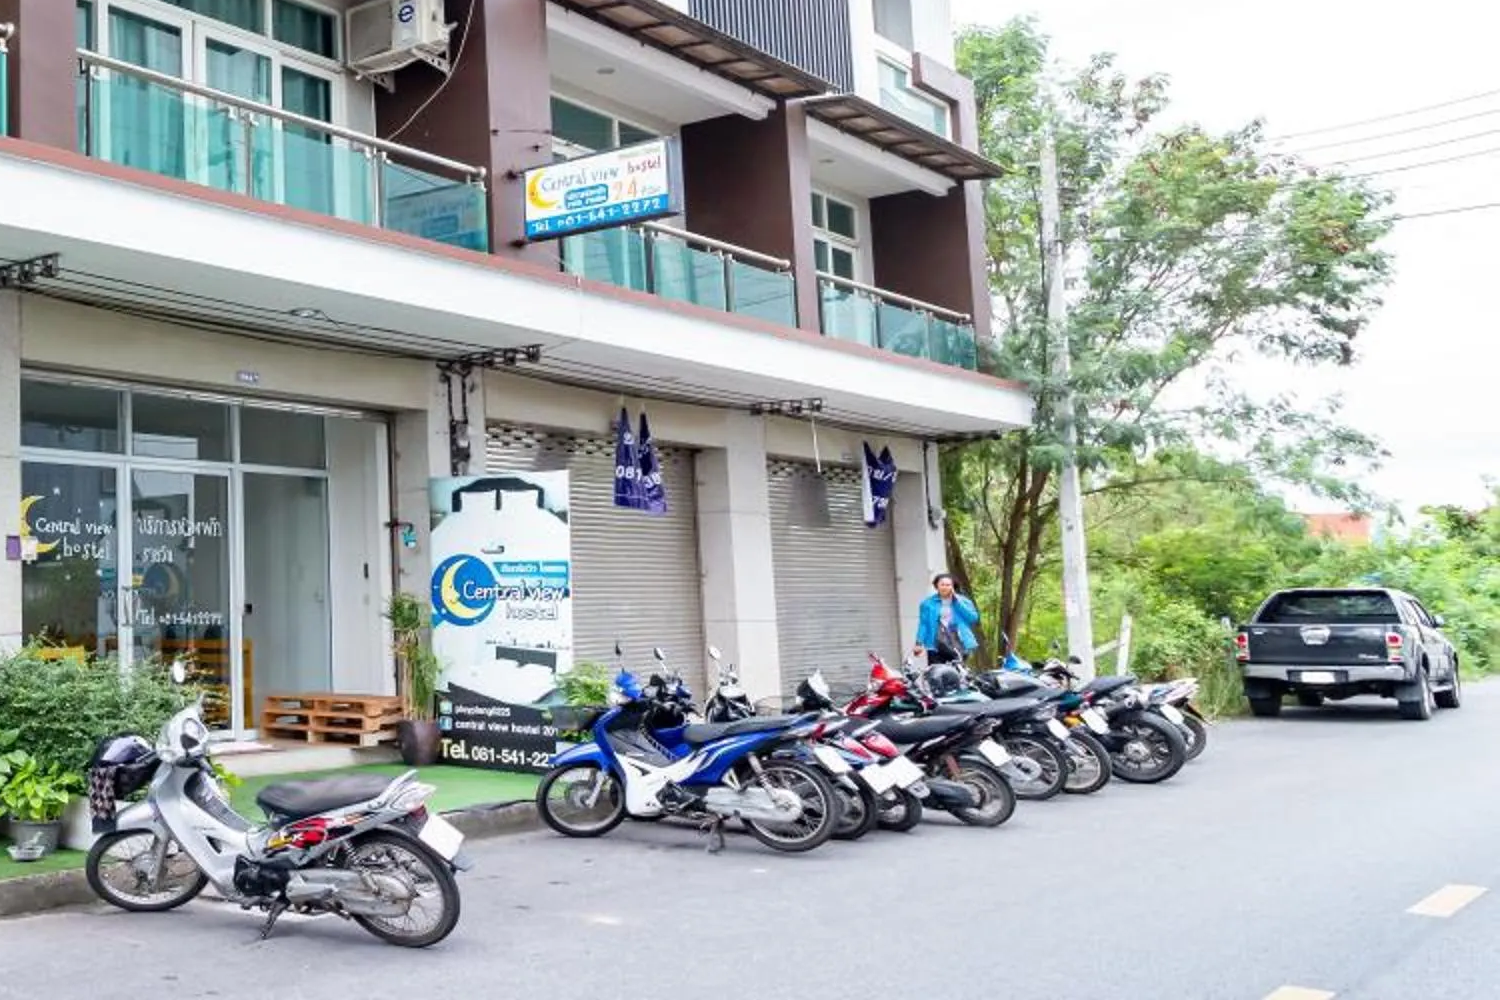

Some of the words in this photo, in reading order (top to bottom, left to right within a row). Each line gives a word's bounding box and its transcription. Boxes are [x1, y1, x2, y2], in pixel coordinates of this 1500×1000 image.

[542, 168, 587, 192] Central
[591, 167, 619, 182] view
[627, 155, 661, 174] hostel
[35, 517, 81, 535] Central
[86, 523, 114, 535] view
[63, 540, 109, 560] hostel
[463, 579, 525, 601] Central
[529, 580, 565, 602] view
[506, 603, 559, 621] hostel
[455, 720, 485, 731] central
[488, 722, 509, 733] view
[511, 723, 540, 735] hostel
[441, 738, 469, 759] Tel.
